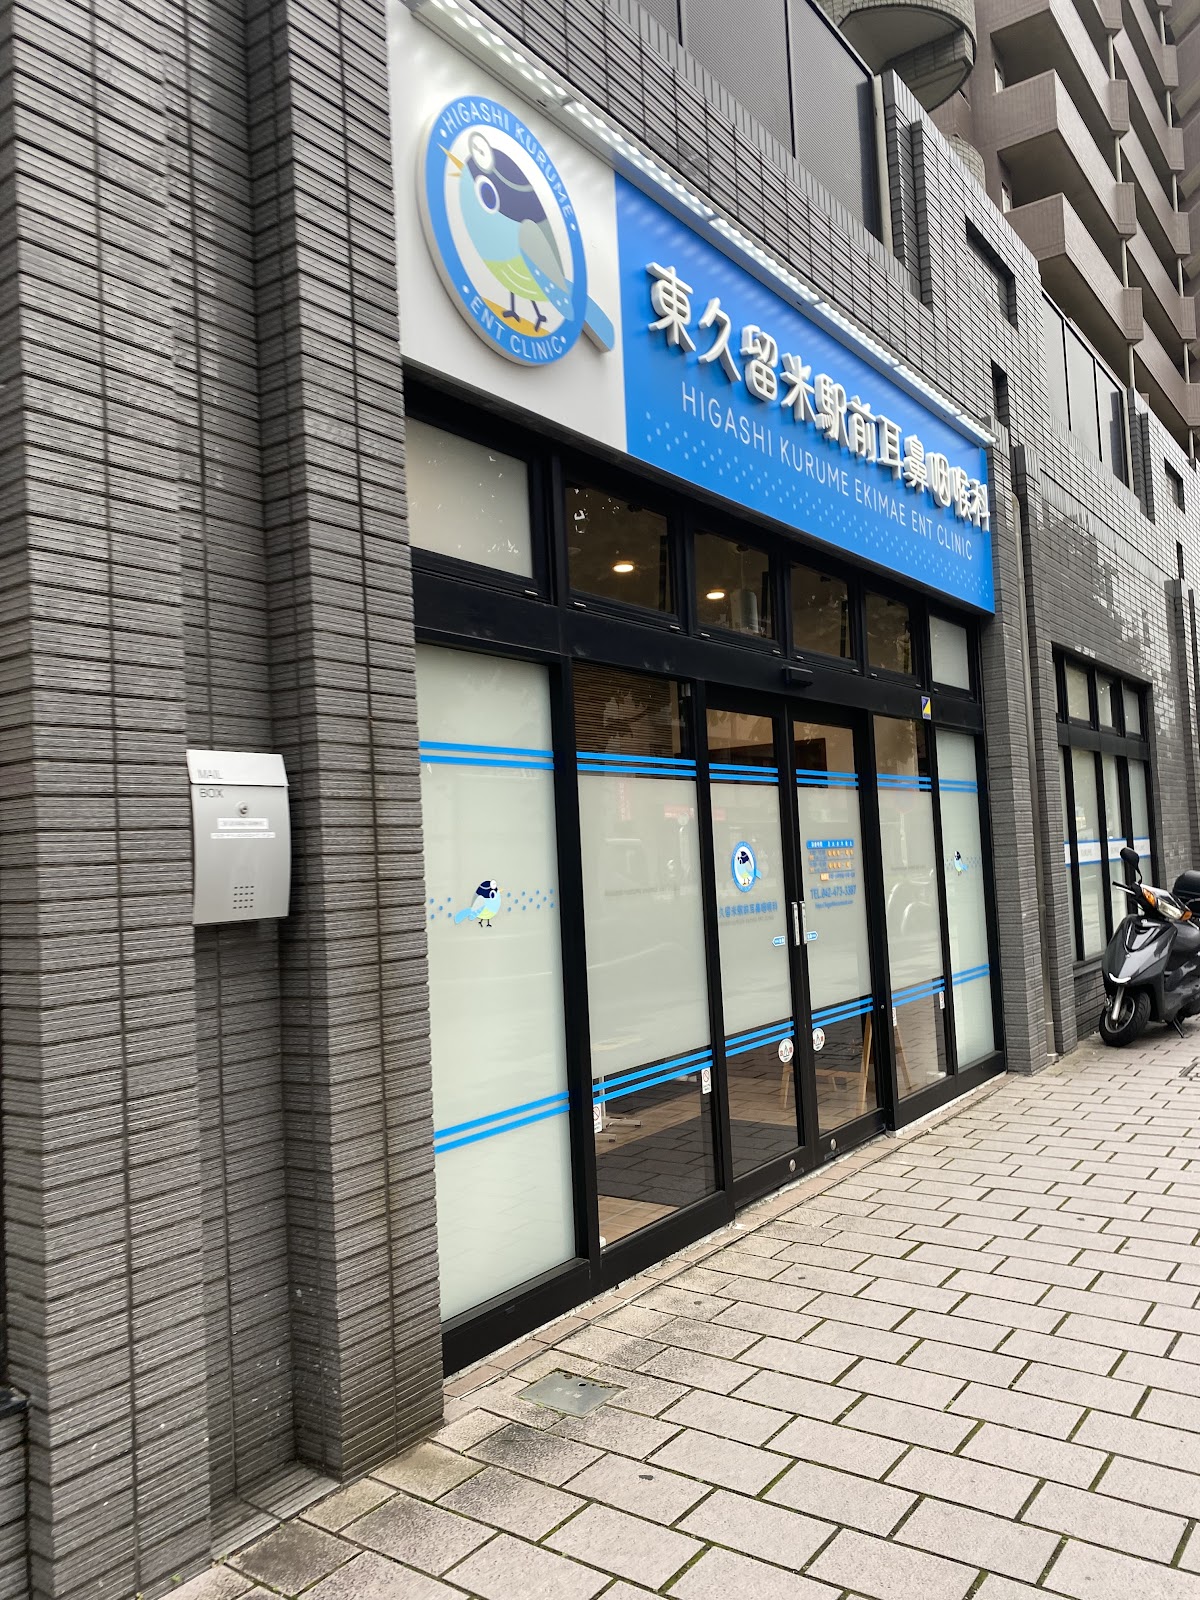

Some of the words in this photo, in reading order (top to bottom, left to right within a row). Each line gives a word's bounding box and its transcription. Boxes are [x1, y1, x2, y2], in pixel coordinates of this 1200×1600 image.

[442, 100, 510, 135] HIGASHI
[514, 122, 574, 219] KURUME
[470, 296, 506, 341] ENT
[509, 334, 563, 361] CLINIC
[645, 261, 991, 533] 東久留米駅前耳鼻咽喉科
[681, 380, 773, 458] HIGASHI
[779, 435, 850, 498] KURUME
[854, 477, 907, 527] EKIMAE
[911, 508, 934, 541] ENT
[936, 523, 973, 561] CLINIC
[197, 768, 224, 780] MAIL
[200, 787, 225, 799] BOX
